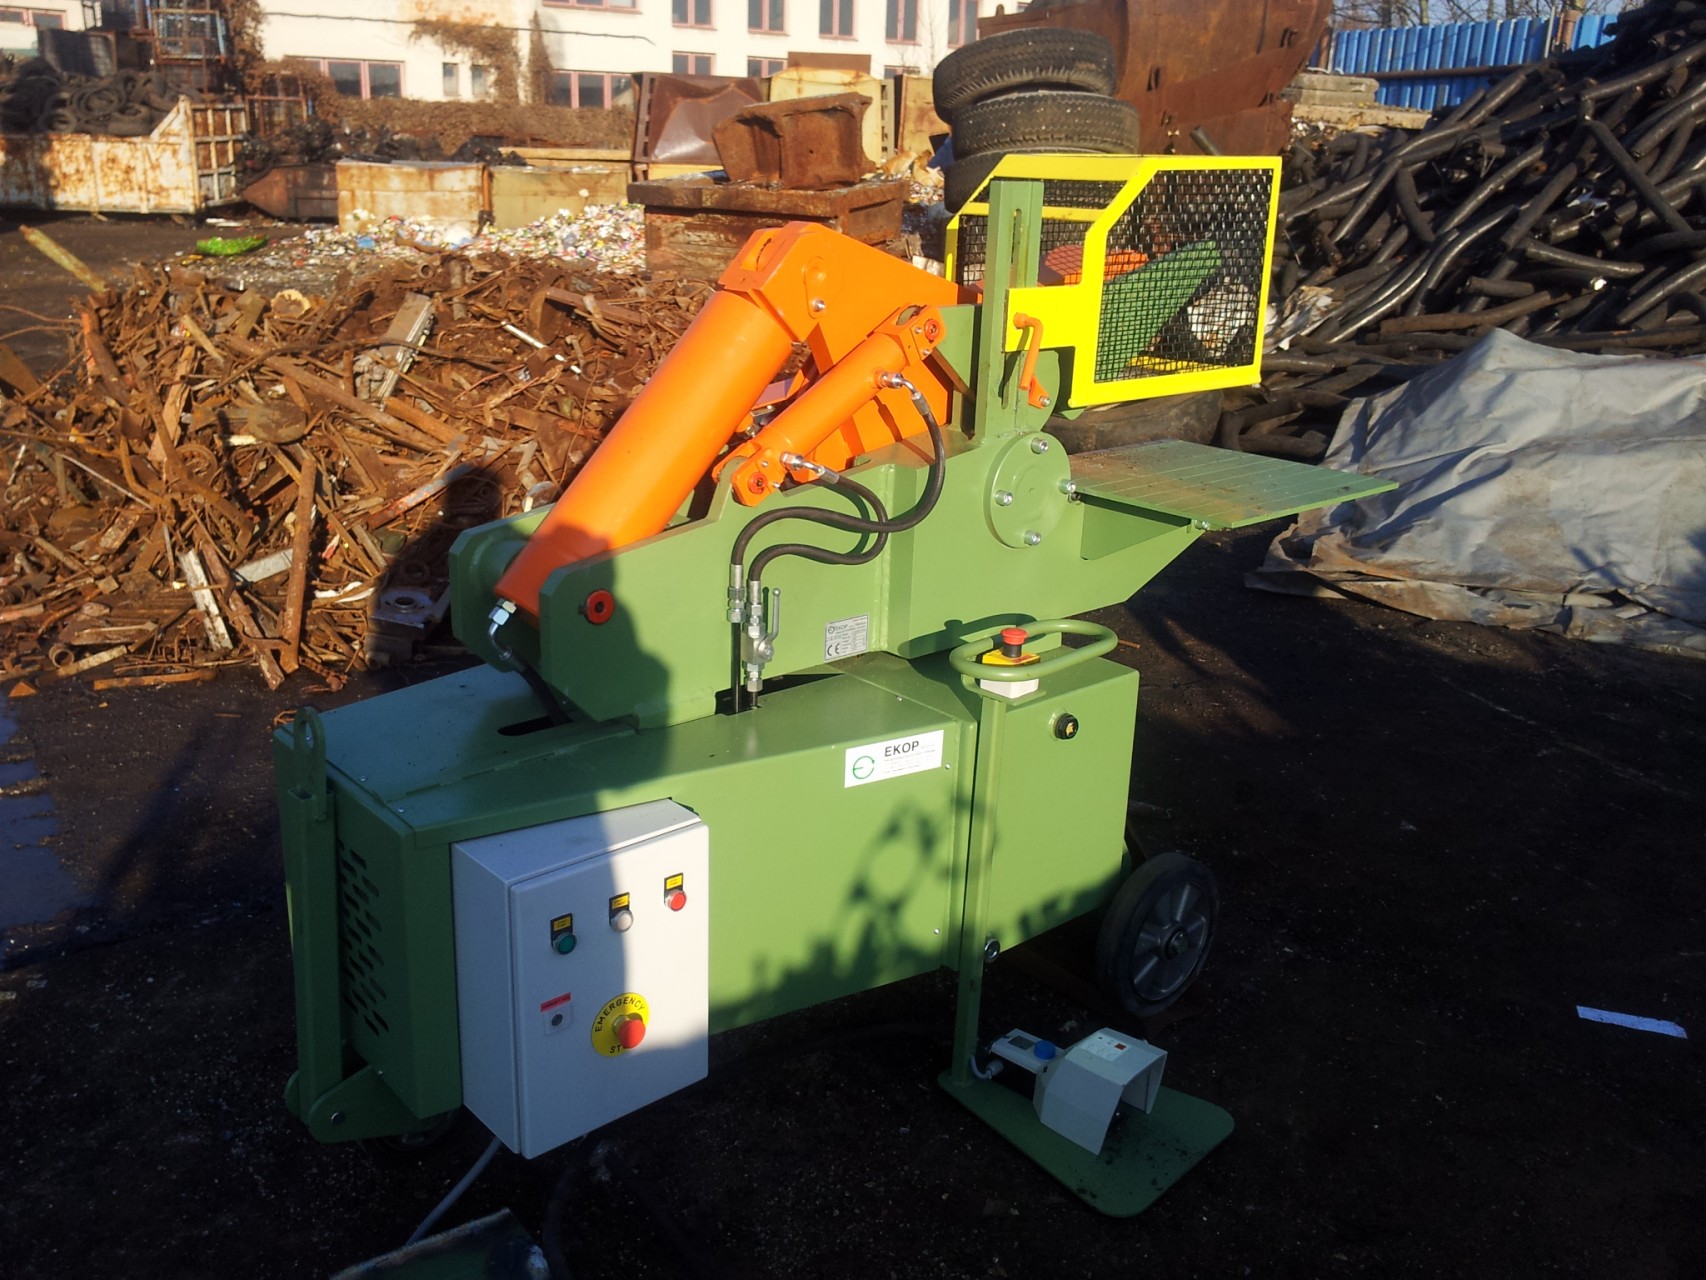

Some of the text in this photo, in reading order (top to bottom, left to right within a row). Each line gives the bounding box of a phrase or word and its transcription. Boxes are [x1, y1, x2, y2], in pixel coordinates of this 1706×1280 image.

[827, 643, 840, 656] CE
[884, 740, 919, 757] EKOP
[595, 996, 645, 1032] EMERGENCY
